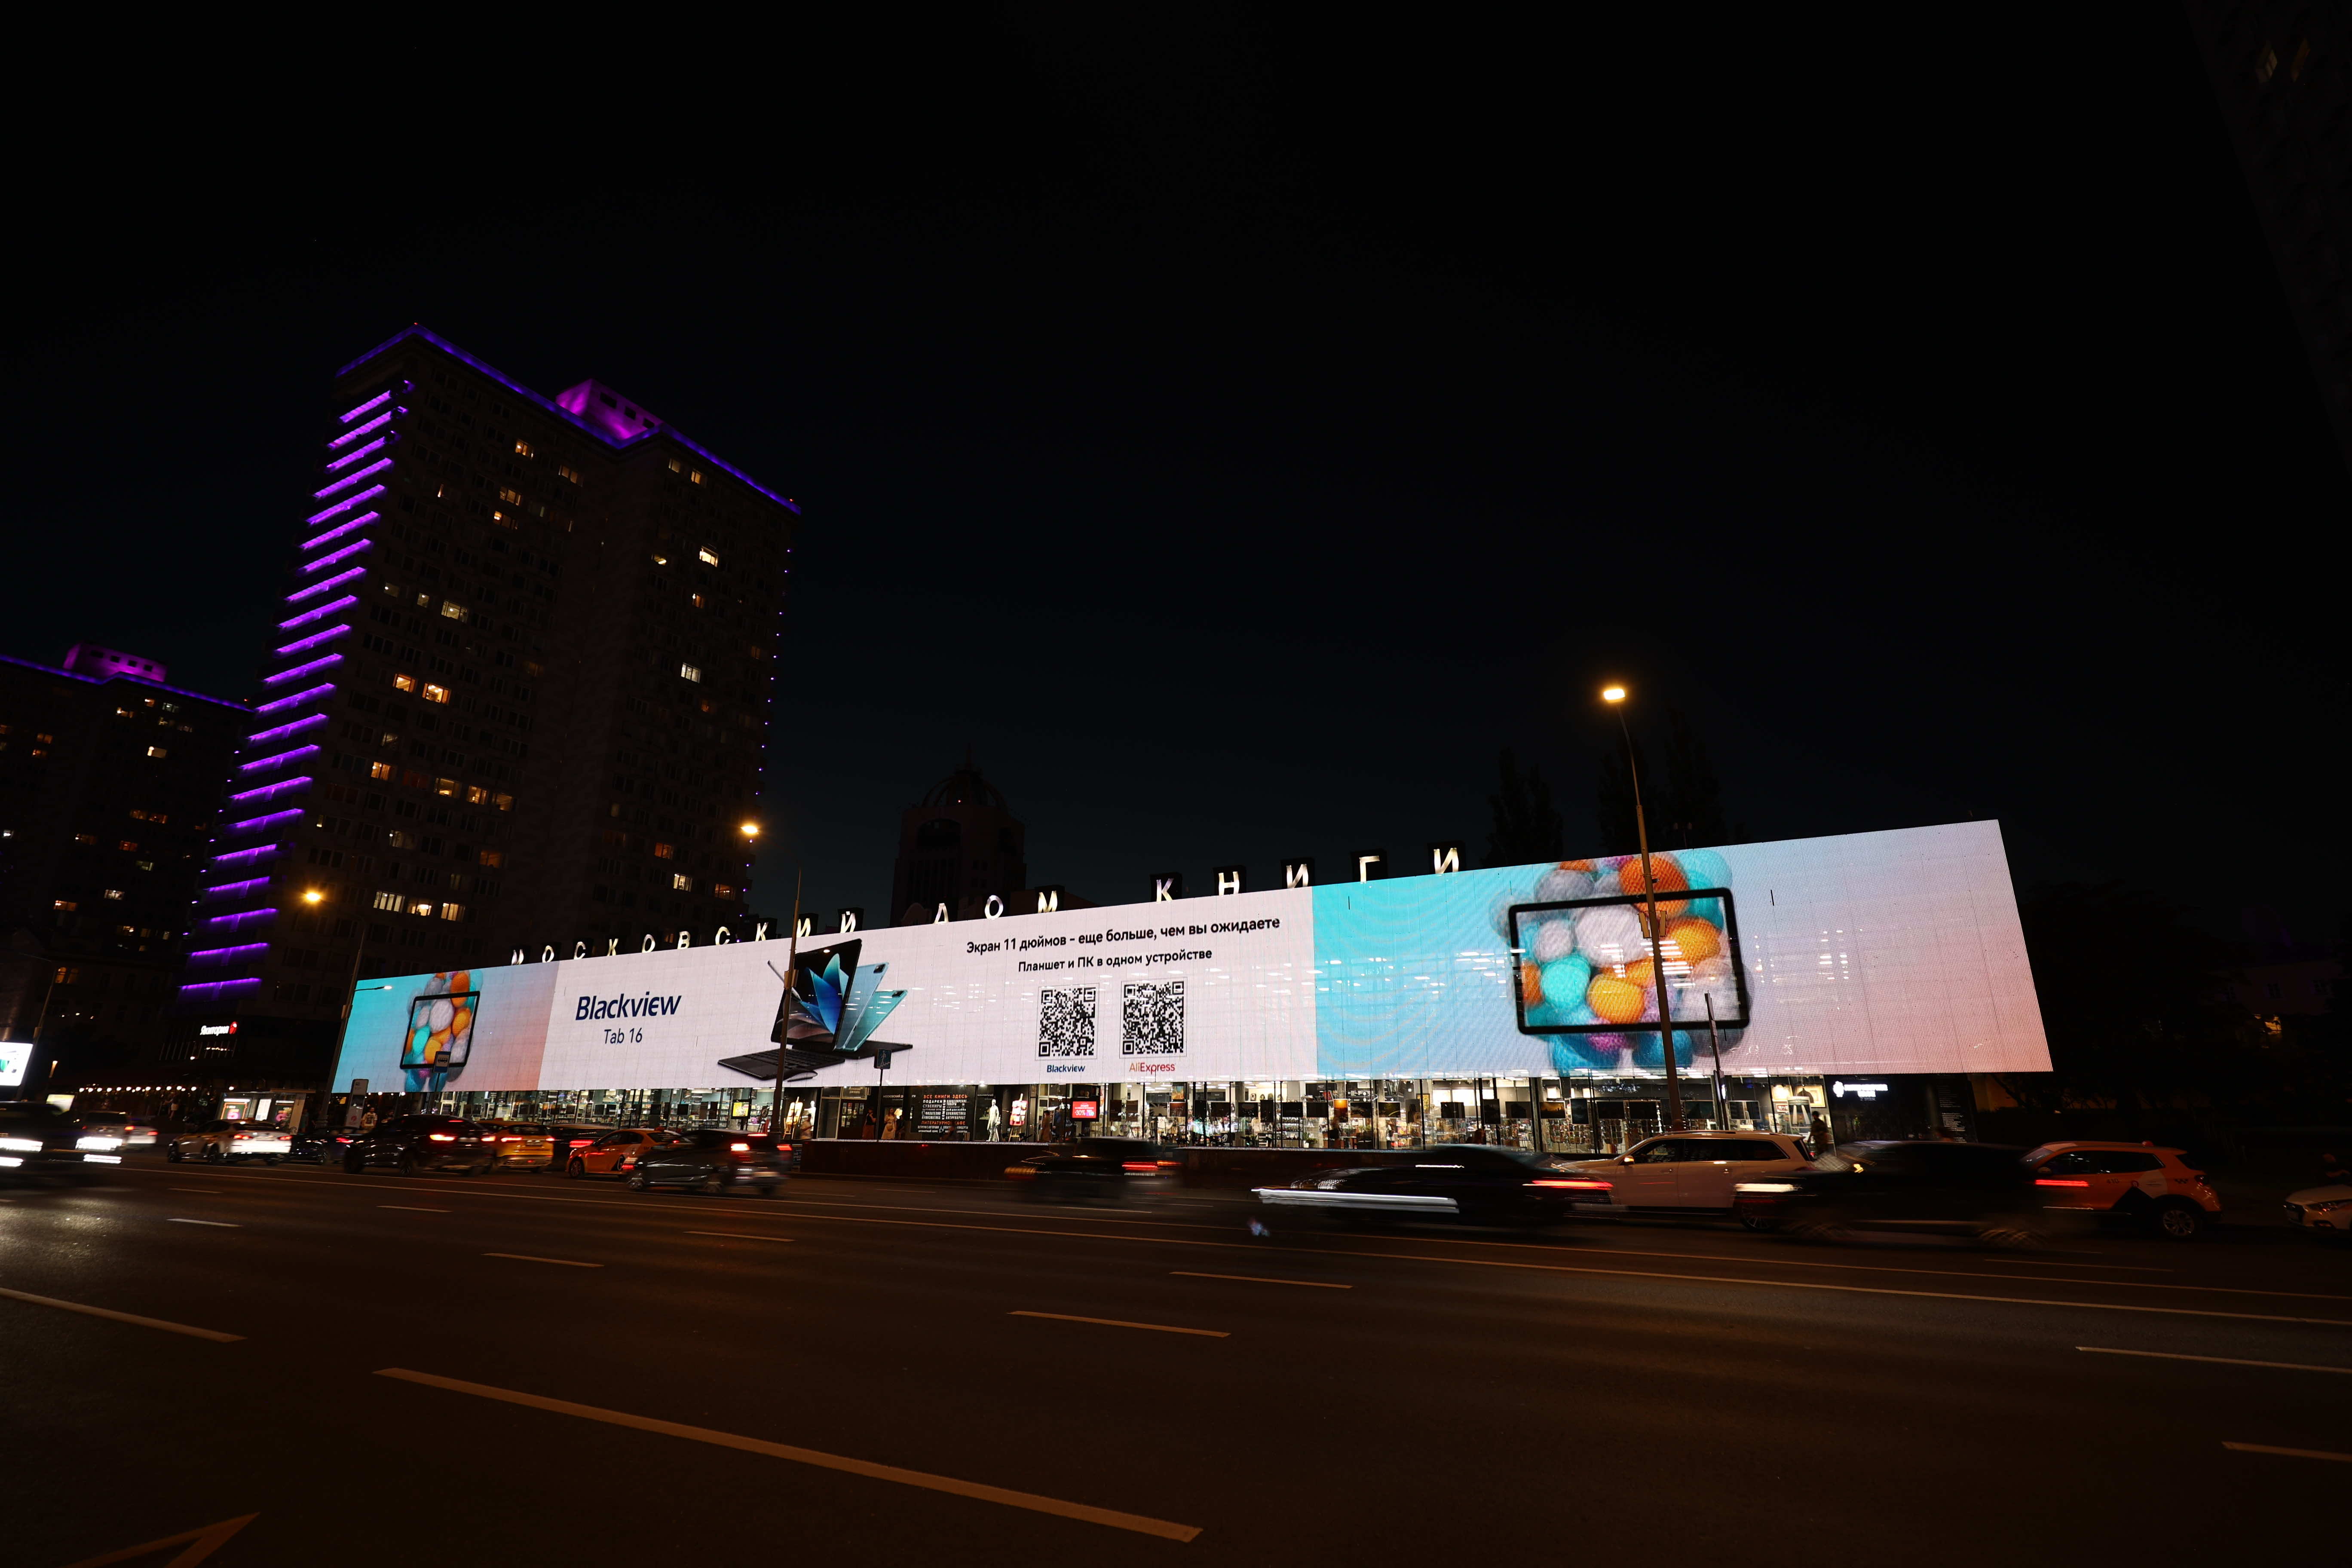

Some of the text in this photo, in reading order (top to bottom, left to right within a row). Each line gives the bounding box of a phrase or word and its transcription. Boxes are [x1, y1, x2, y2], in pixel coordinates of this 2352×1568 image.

[511, 847, 1459, 966] МОСКОВСКИЙ ДОМ КНИГИ
[967, 942, 1000, 955] Экран
[1004, 938, 1016, 950] 11
[1020, 936, 1066, 952] дюймов
[1078, 933, 1103, 945] еще
[1106, 929, 1157, 941] больше,
[1161, 925, 1185, 937] чем
[1188, 924, 1207, 935] вы
[1211, 918, 1280, 934] ожидаете
[1019, 961, 1065, 972] Планшет
[1078, 956, 1094, 967] ПК
[1097, 958, 1103, 966] в
[1106, 955, 1142, 967] одном
[1145, 949, 1212, 966] устройстве
[576, 991, 682, 1020] Blackview
[604, 1028, 643, 1044] Tab 16
[1129, 1063, 1176, 1075] AliExpress
